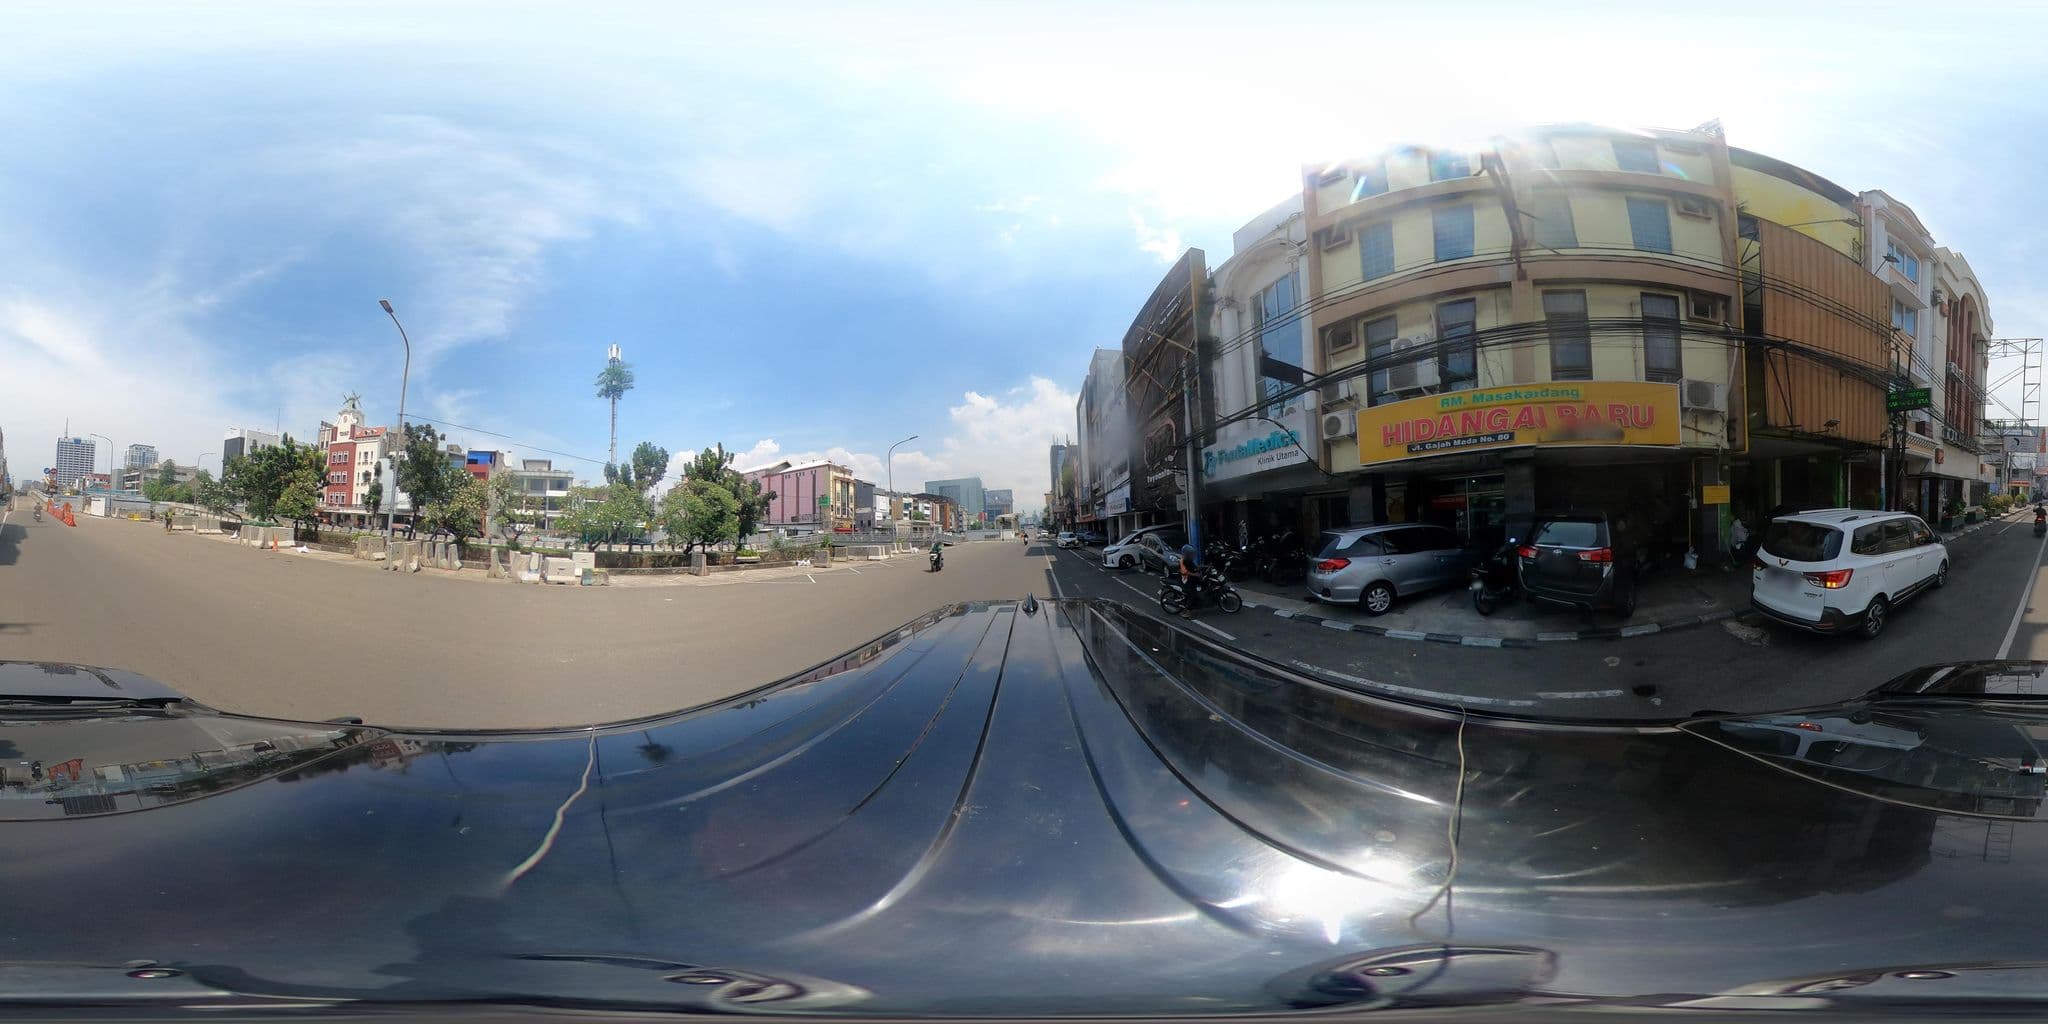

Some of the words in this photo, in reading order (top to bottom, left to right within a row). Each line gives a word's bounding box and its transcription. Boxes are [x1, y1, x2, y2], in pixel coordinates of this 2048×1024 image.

[1440, 396, 1466, 408] RM.
[1425, 441, 1451, 451] Gajah
[1453, 438, 1478, 447] Mada
[1480, 435, 1495, 444] No.
[1257, 455, 1275, 466] Klinik
[1276, 449, 1299, 461] Utama
